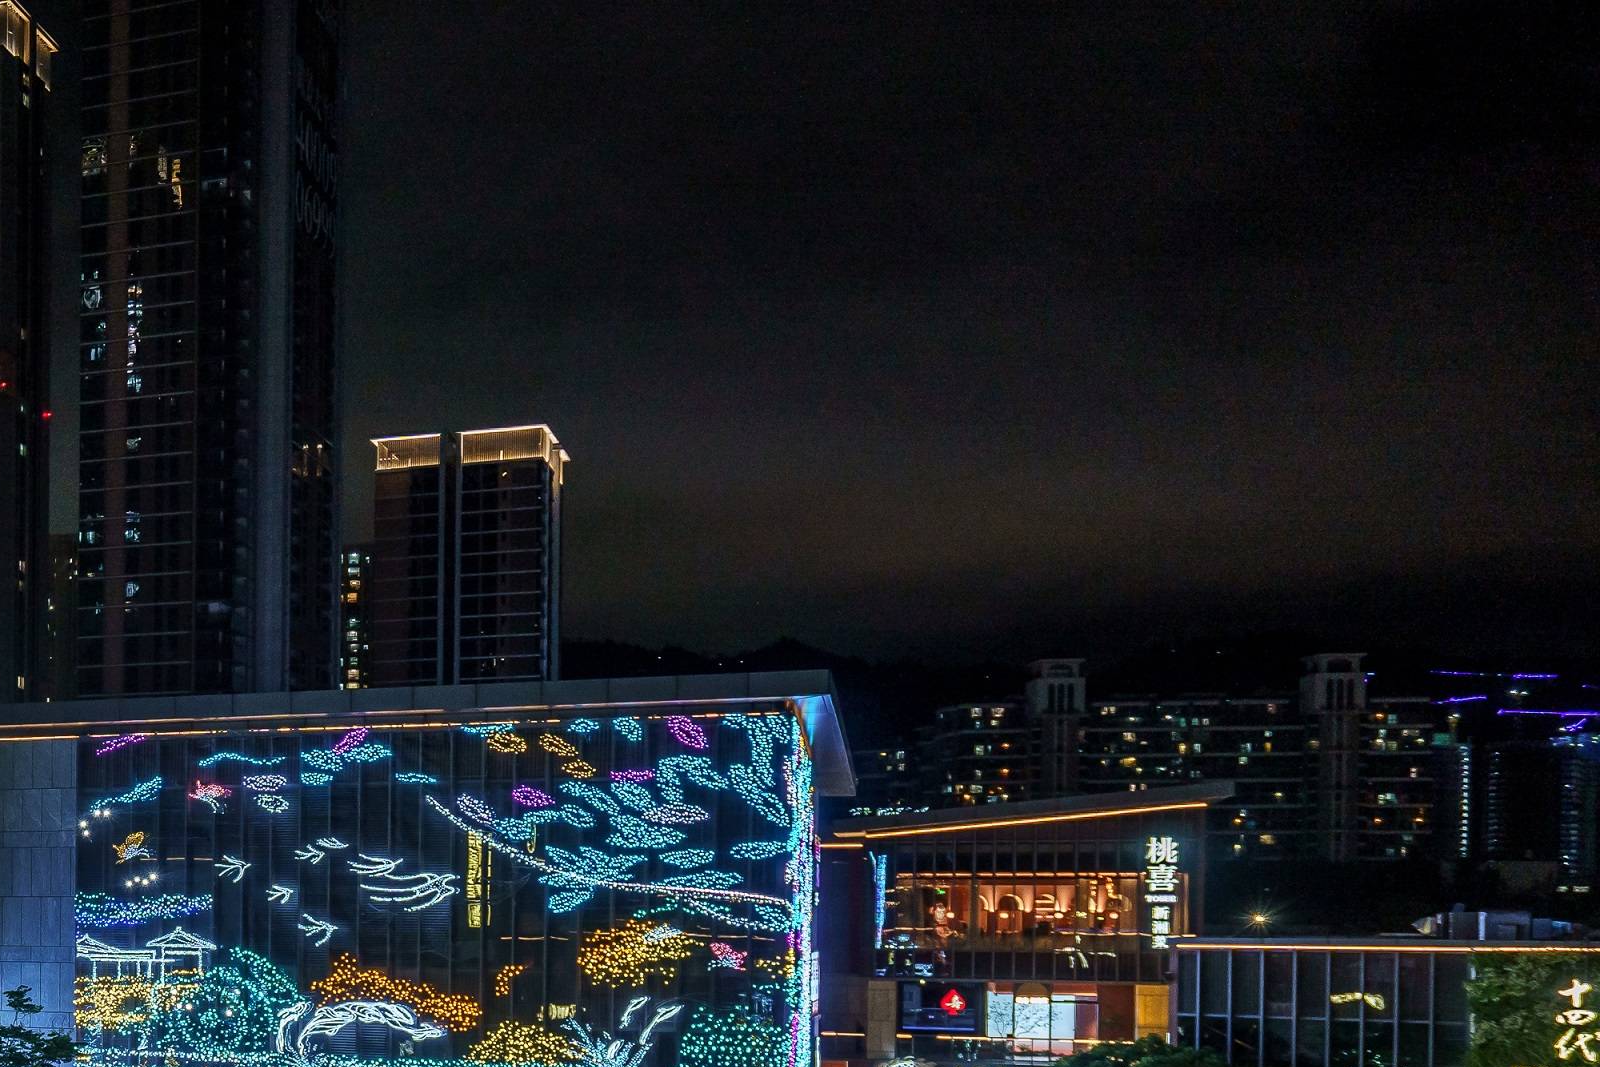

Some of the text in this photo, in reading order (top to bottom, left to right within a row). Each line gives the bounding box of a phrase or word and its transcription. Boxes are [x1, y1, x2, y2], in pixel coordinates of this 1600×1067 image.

[1145, 837, 1179, 892] 桃喜
[1554, 978, 1600, 1062] 十四代
